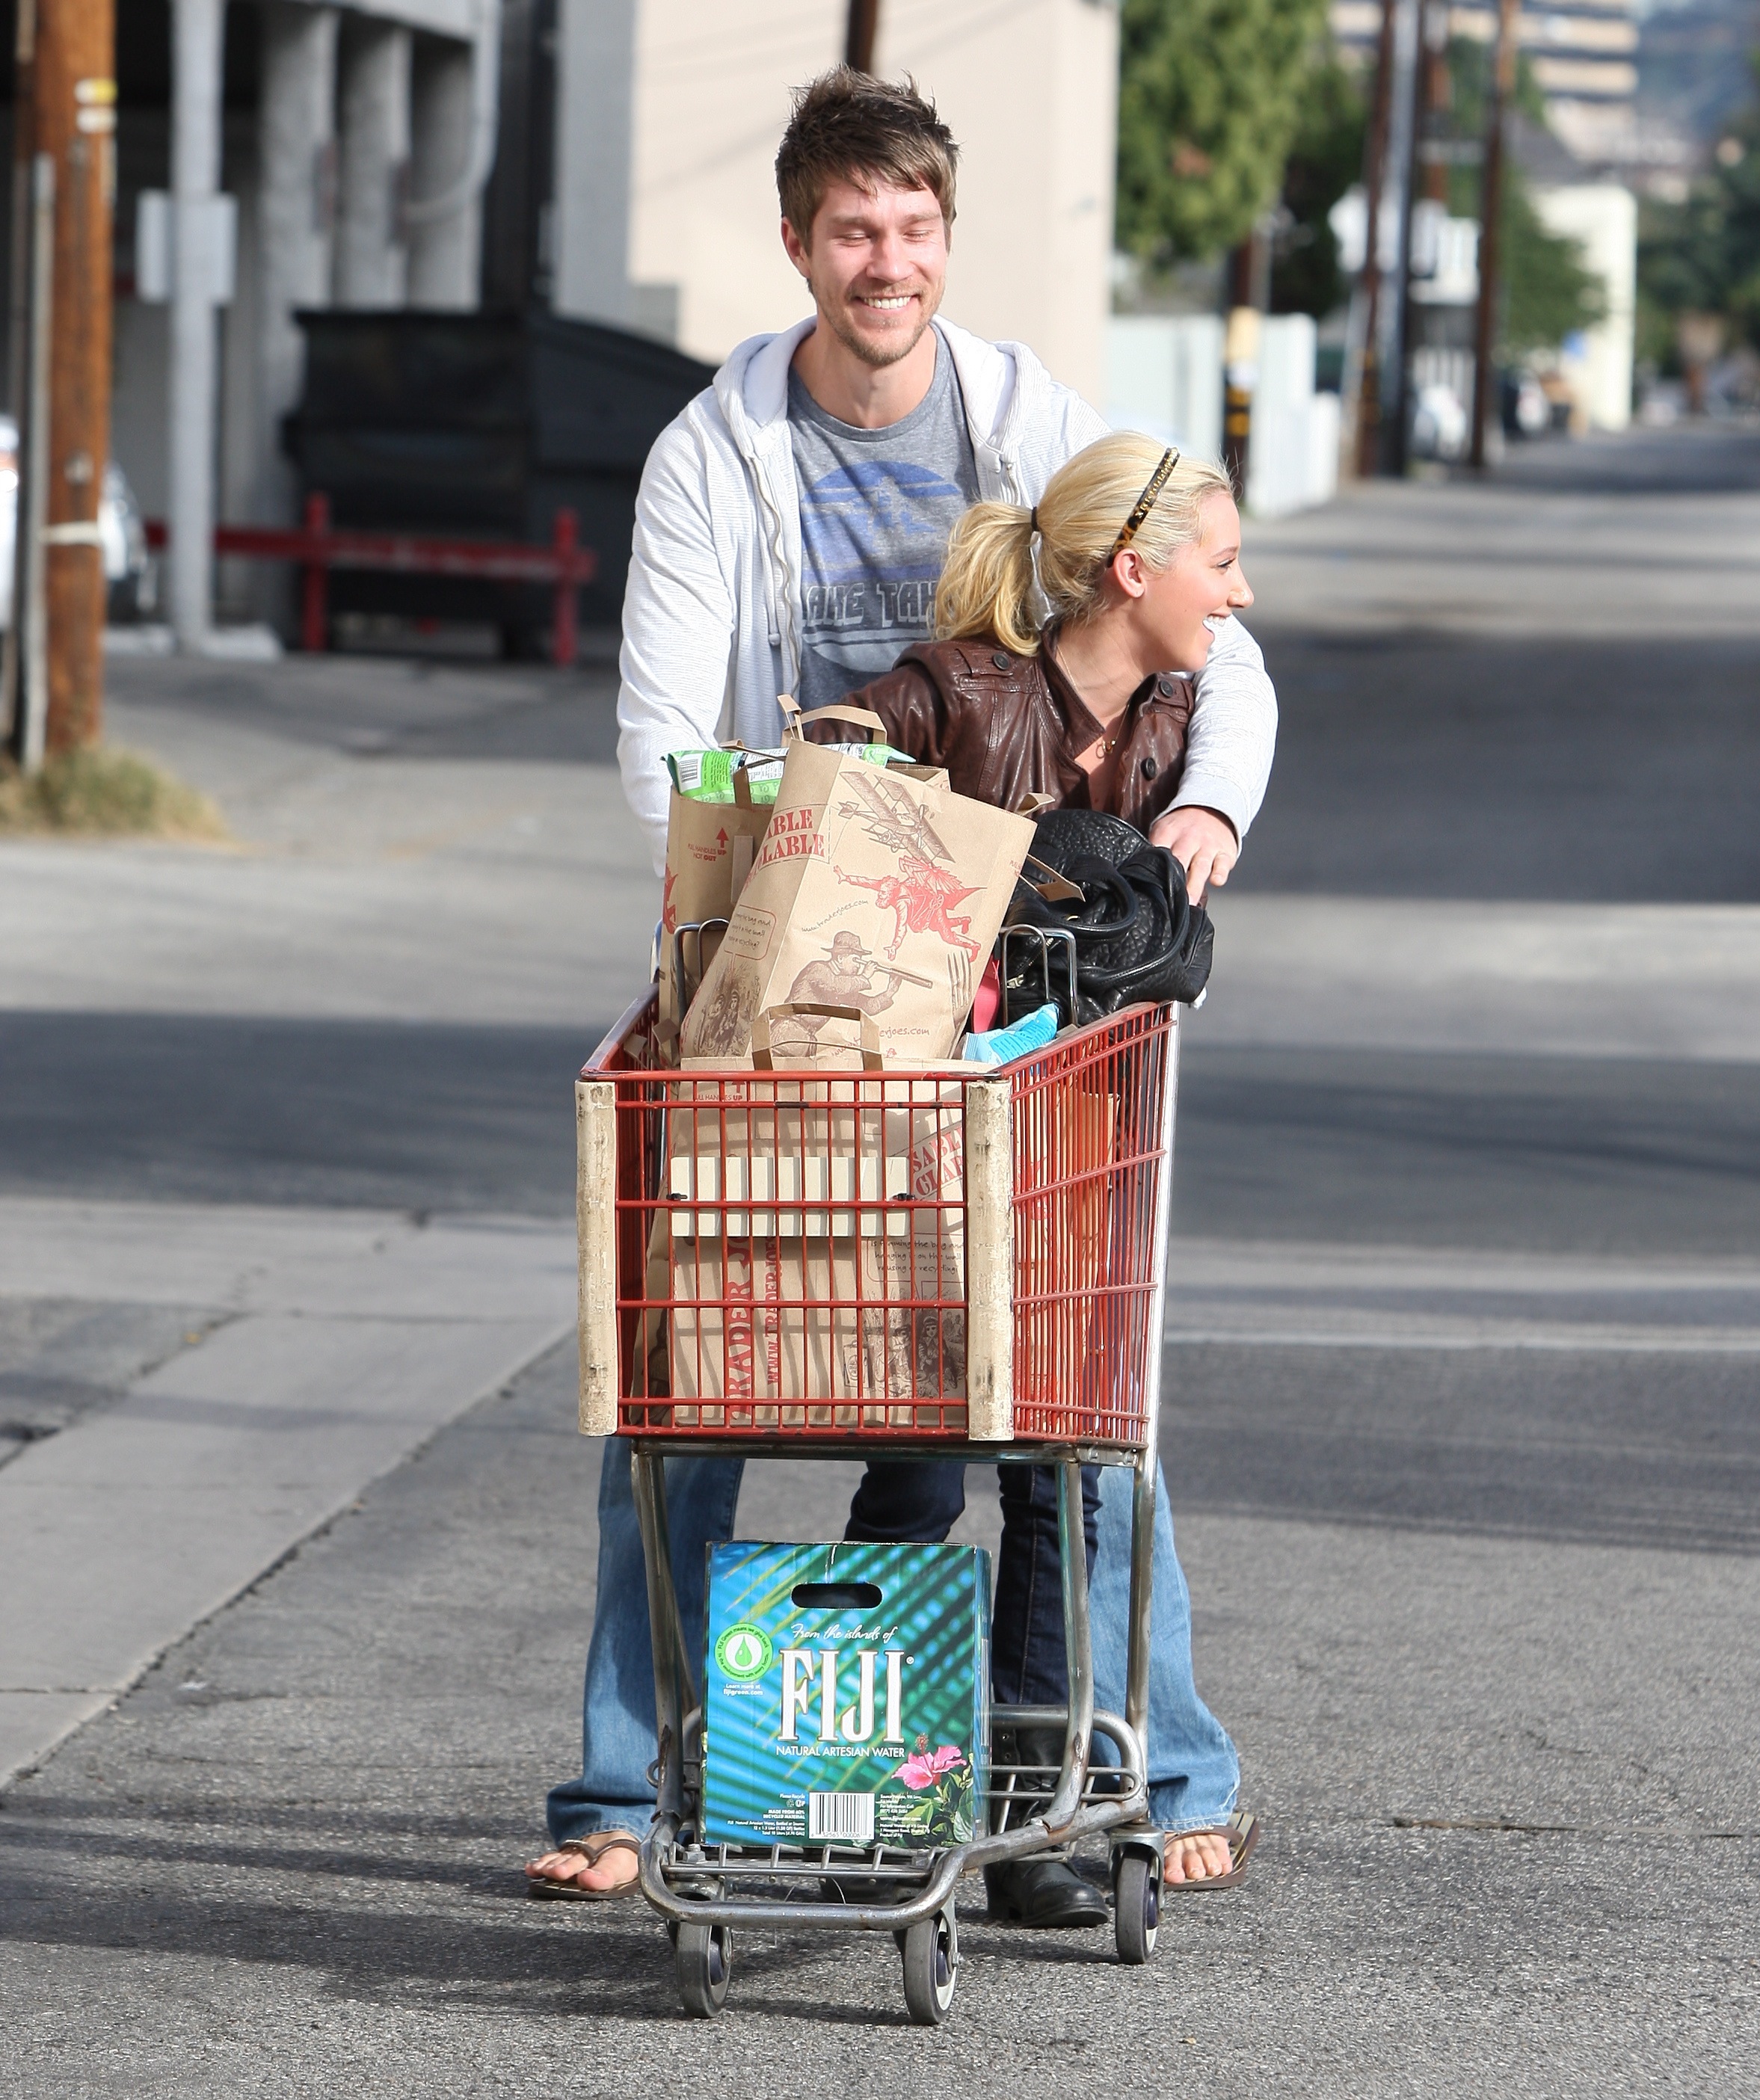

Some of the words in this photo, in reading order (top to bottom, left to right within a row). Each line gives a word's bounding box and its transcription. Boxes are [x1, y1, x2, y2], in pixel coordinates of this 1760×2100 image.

[802, 582, 864, 626] AKE
[876, 581, 940, 628] TAH
[931, 1242, 947, 1250] bg
[791, 1623, 820, 1639] From
[823, 1624, 843, 1639] the
[844, 1625, 881, 1641] islands
[883, 1627, 898, 1643] of
[778, 1649, 905, 1743] FIJI
[776, 1746, 820, 1756] NATURAL
[823, 1746, 870, 1757] ARTESIAN
[872, 1747, 905, 1757] WATER
